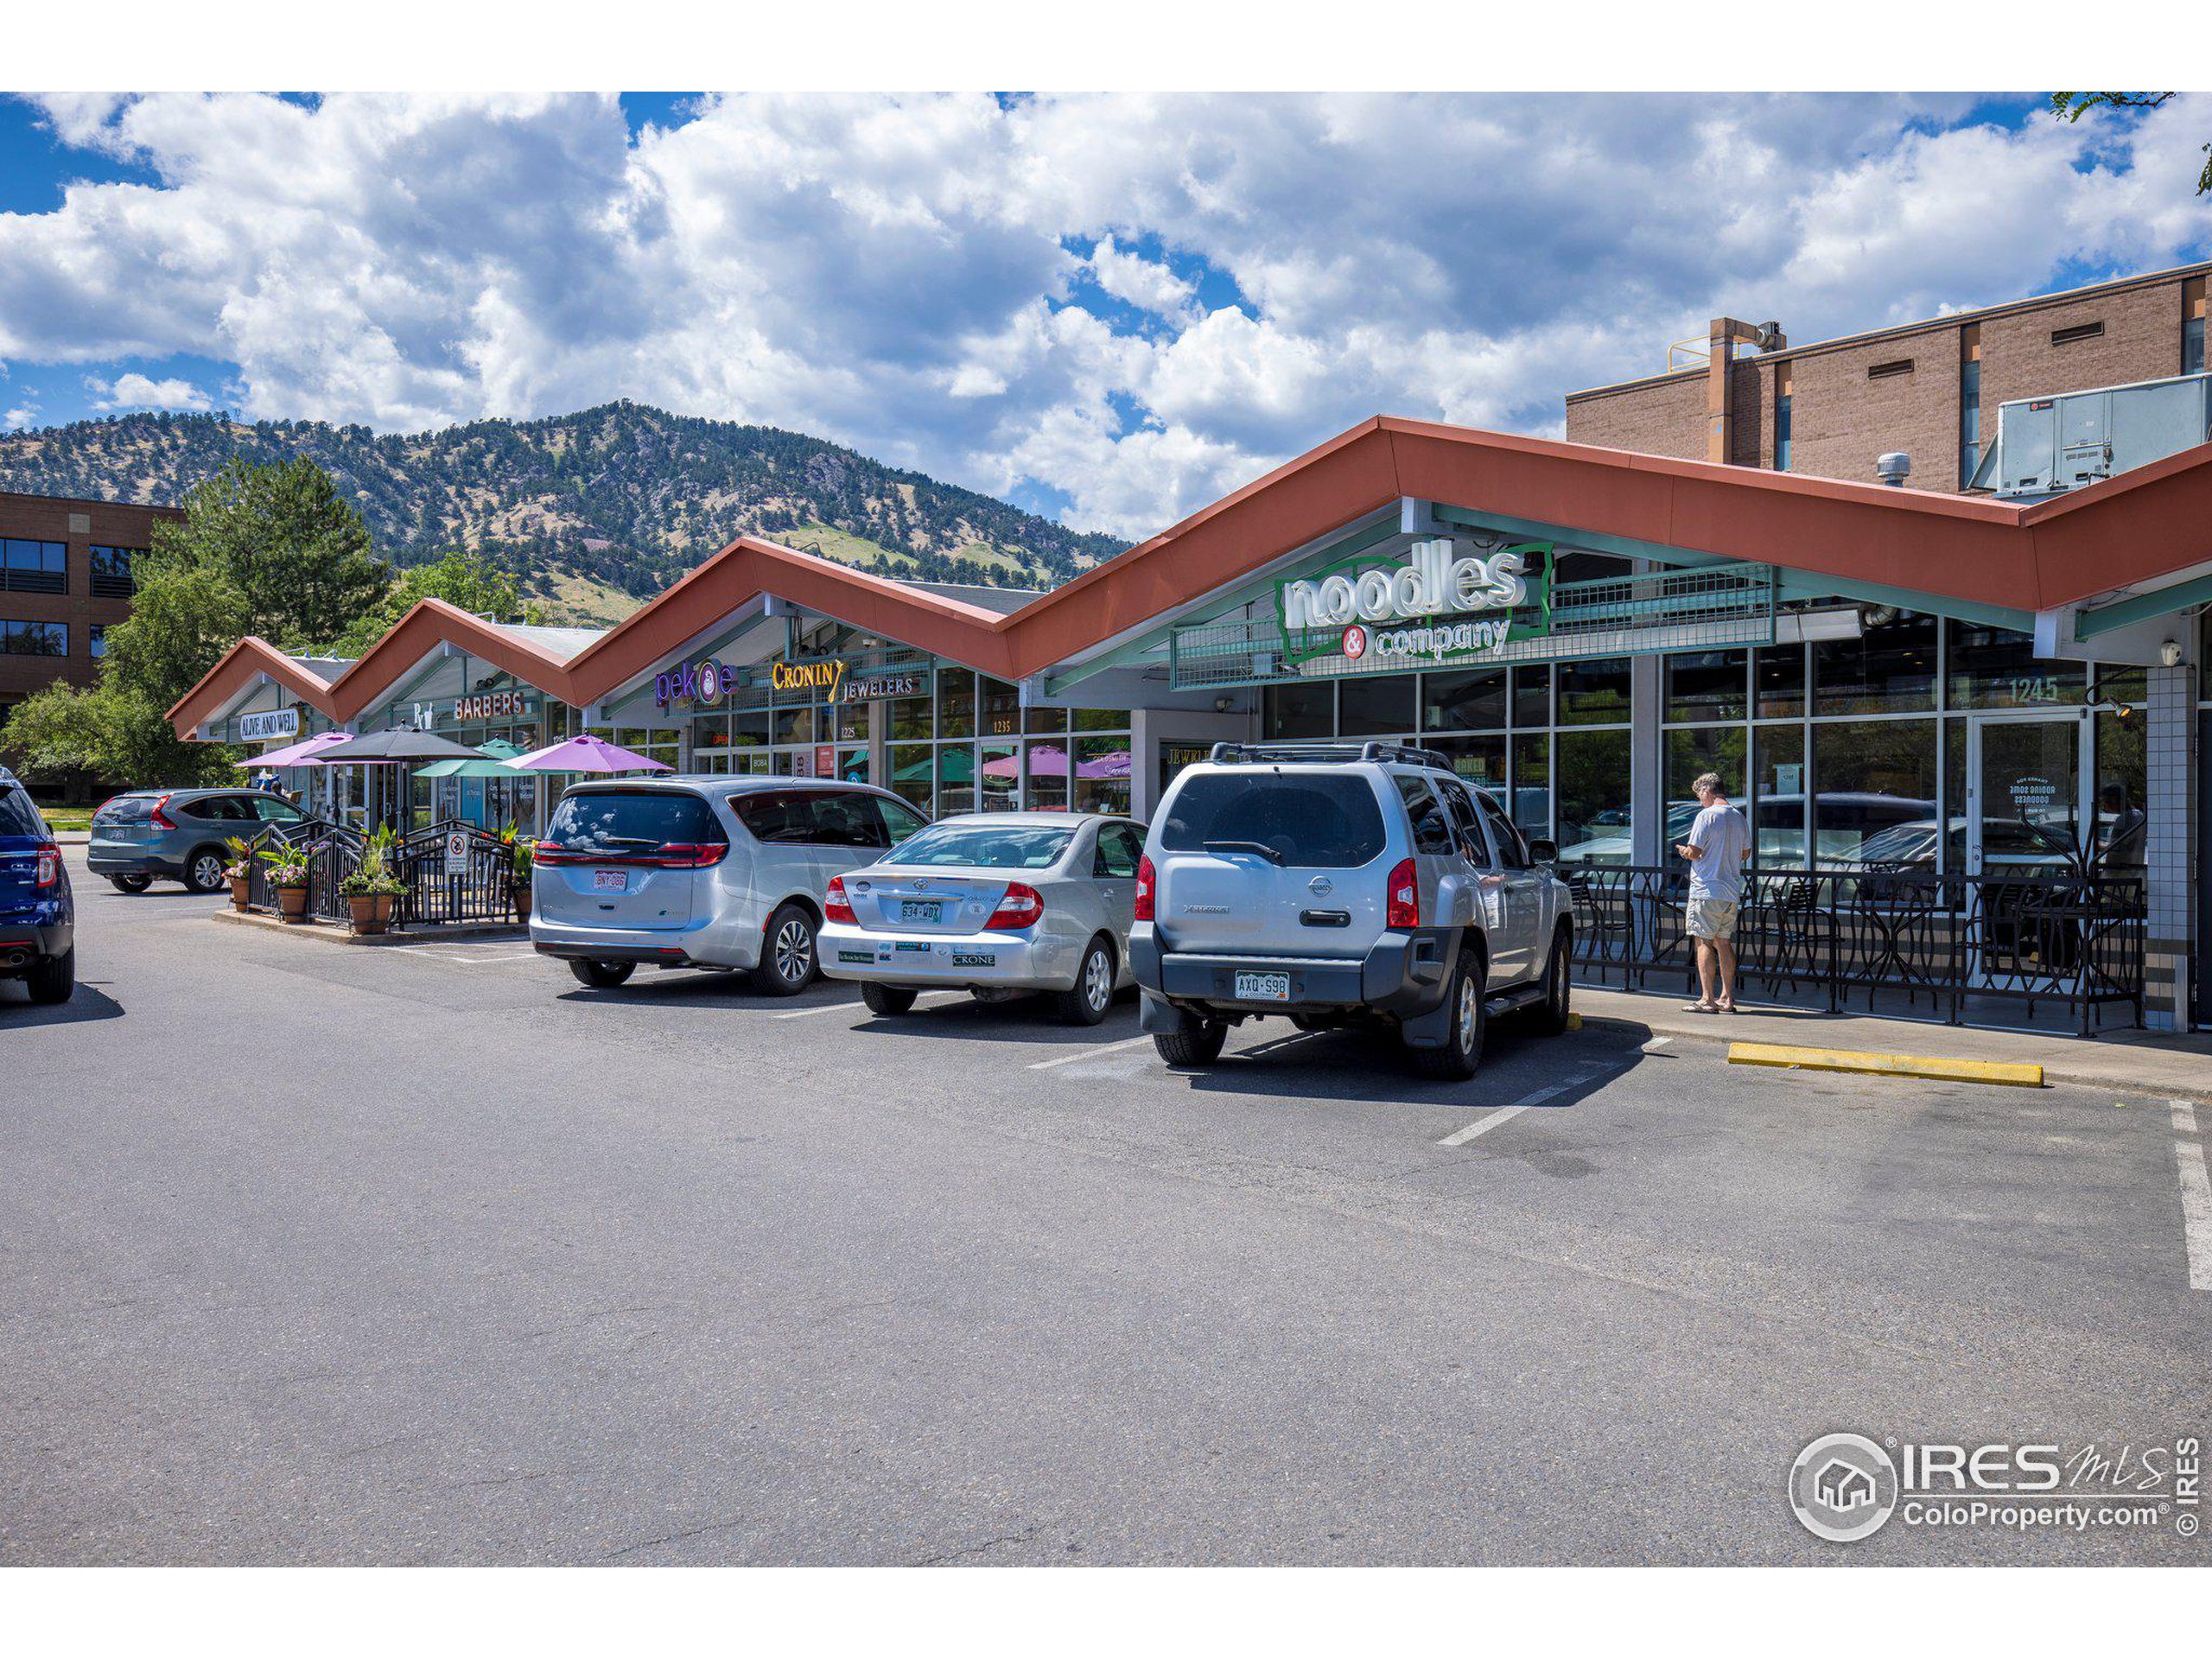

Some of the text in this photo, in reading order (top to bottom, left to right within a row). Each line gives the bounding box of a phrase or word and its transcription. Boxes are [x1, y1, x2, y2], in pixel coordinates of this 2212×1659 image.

[1284, 539, 1527, 629] noodles
[1376, 619, 1511, 661] company
[772, 662, 913, 704] CRONIN JEWELERS
[2009, 677, 2058, 702] 1245
[454, 692, 522, 721] BARBERS
[242, 712, 297, 736] ALIVE AND WELL
[841, 727, 855, 739] 1225
[994, 720, 1011, 734] 1235
[953, 956, 995, 964] CRONE
